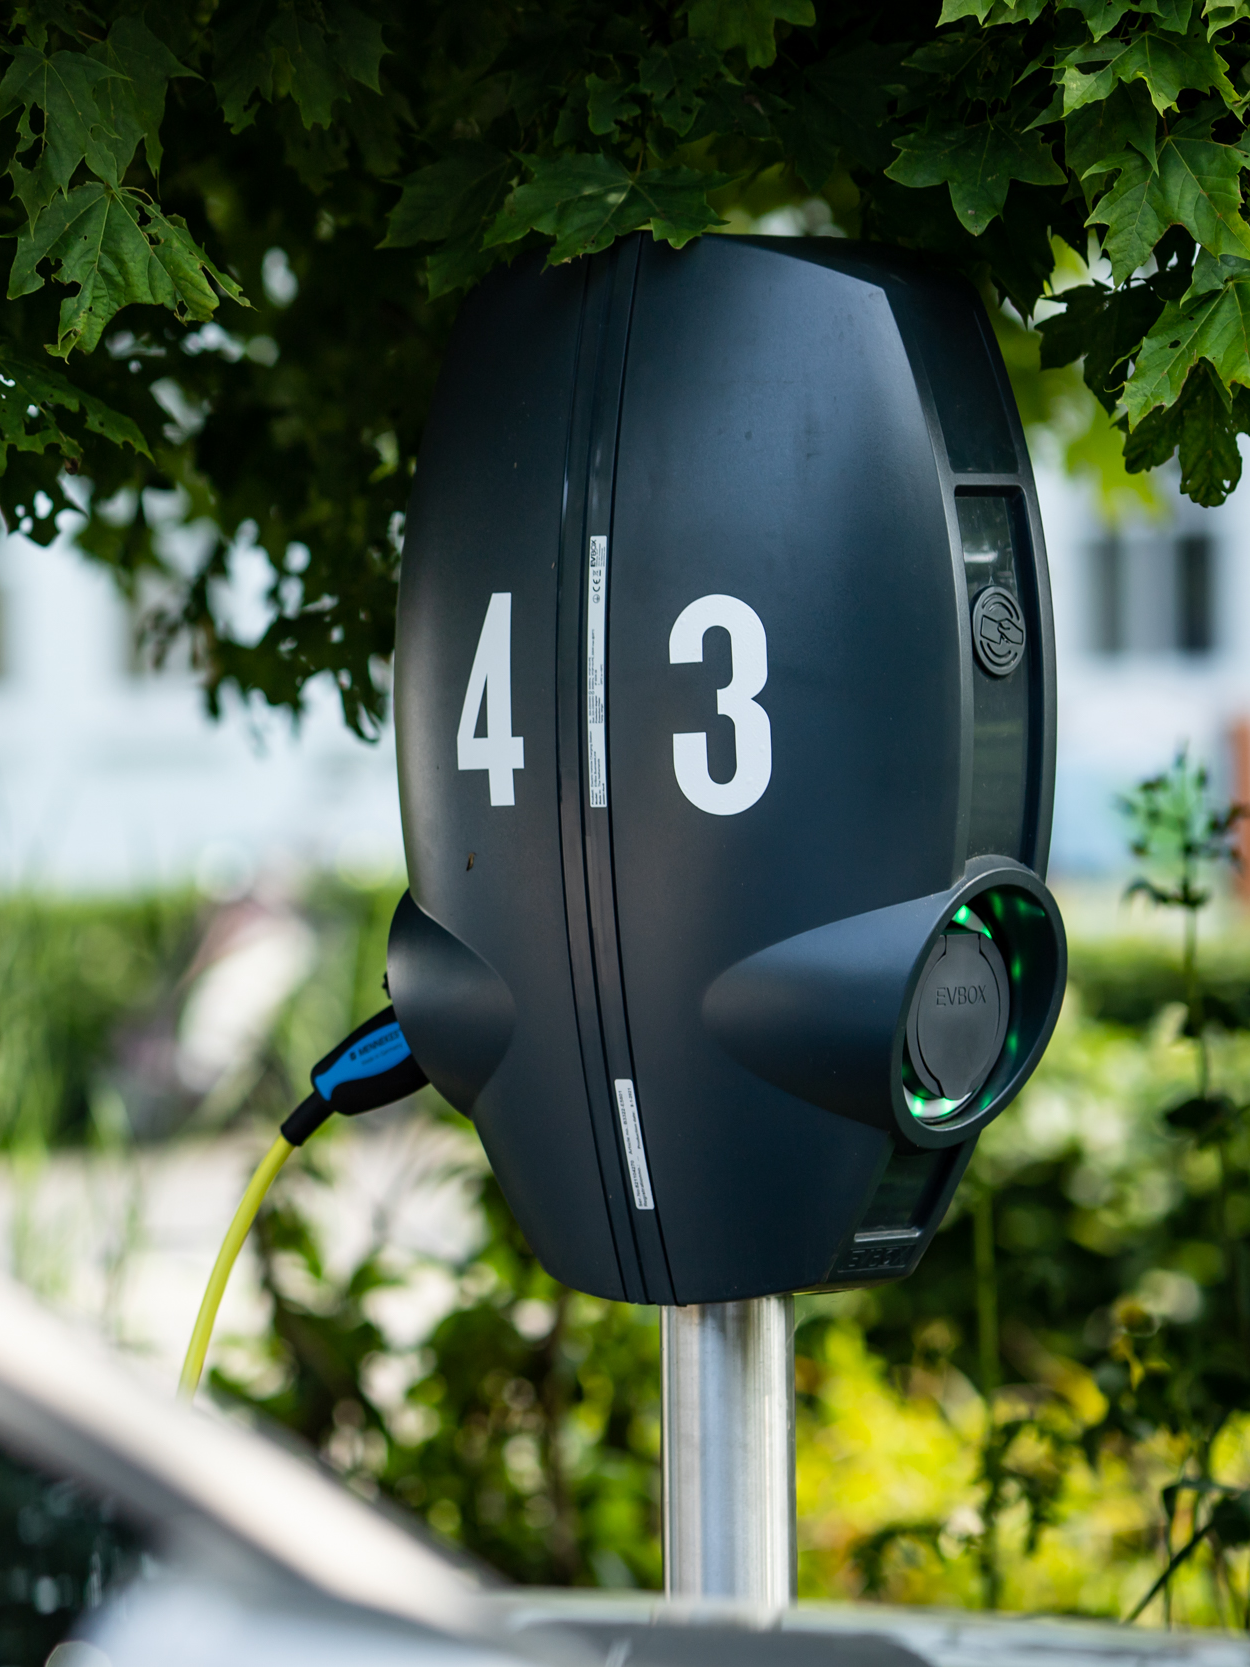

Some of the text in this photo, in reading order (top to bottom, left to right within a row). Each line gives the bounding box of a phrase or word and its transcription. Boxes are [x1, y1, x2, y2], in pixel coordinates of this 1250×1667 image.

[456, 592, 525, 807] 4
[668, 593, 772, 816] 3
[936, 984, 987, 1007] EVBOX
